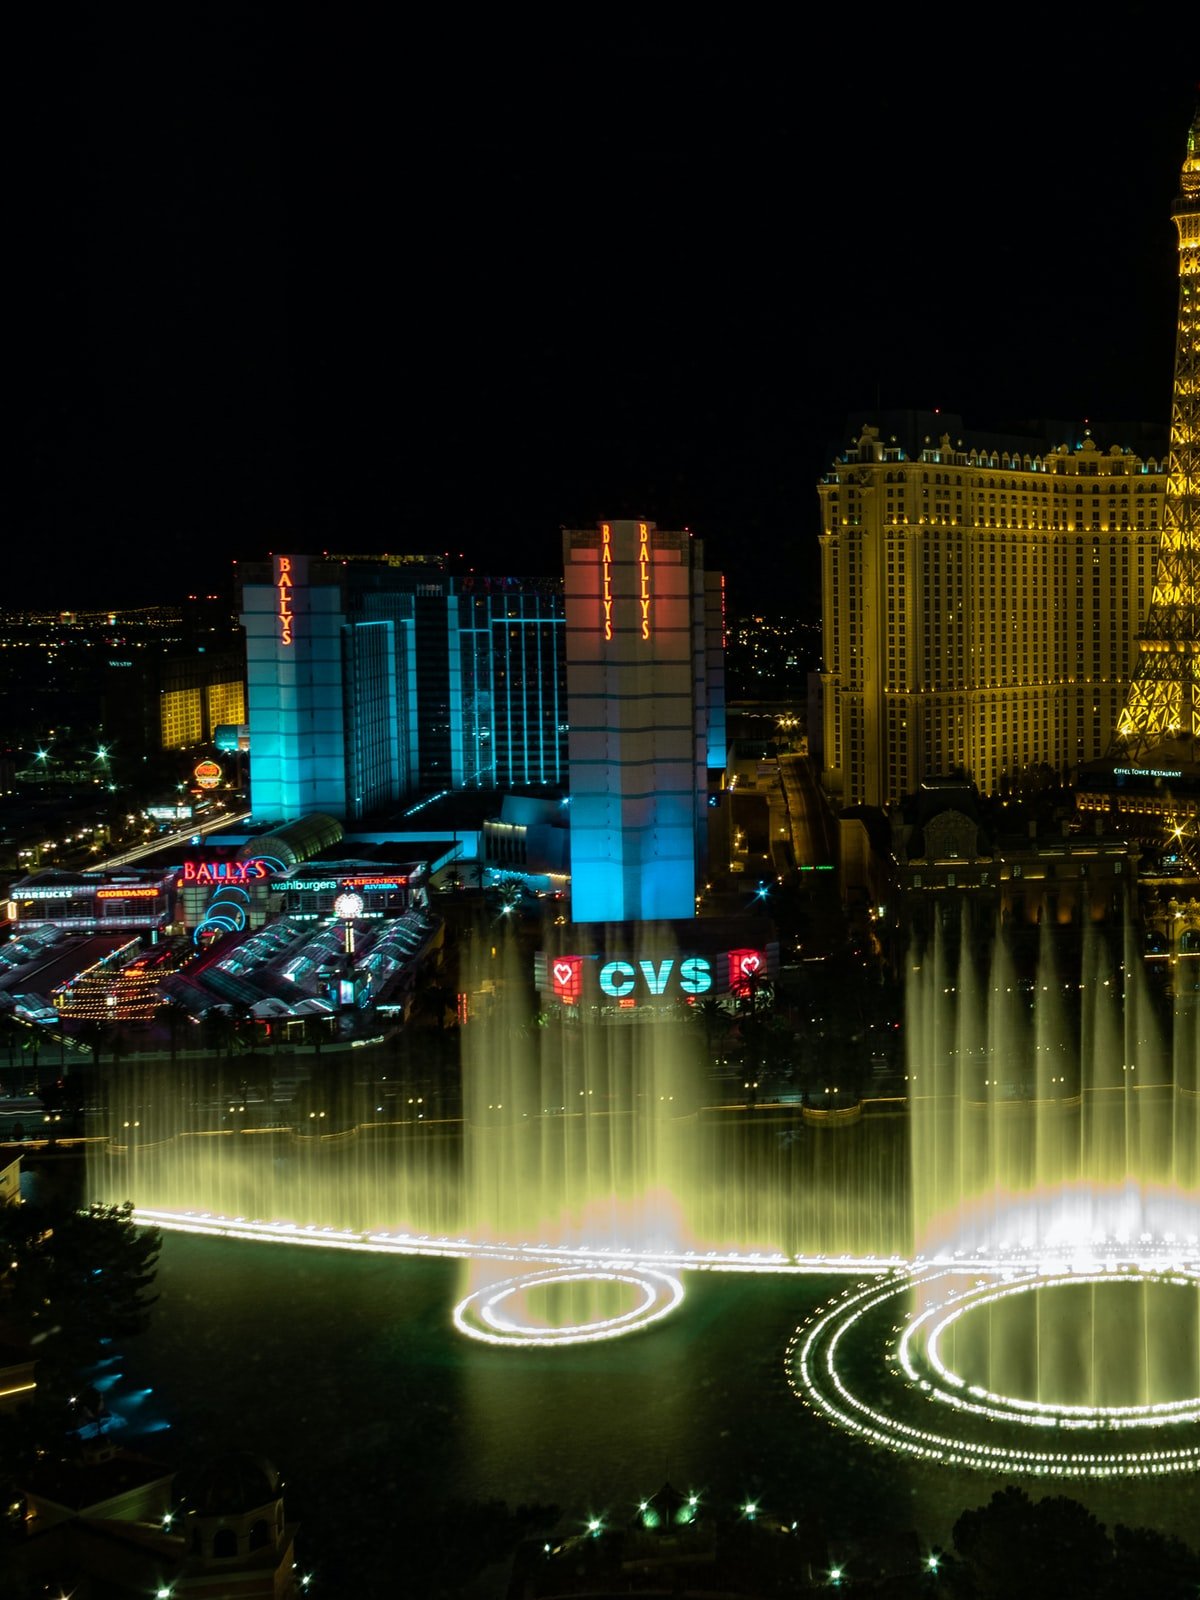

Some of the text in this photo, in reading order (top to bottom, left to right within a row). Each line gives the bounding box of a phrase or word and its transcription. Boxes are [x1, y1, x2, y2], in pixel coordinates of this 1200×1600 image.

[184, 860, 267, 880] BALLY'S
[271, 880, 337, 891] wahlburgers
[354, 877, 406, 886] REDNECK
[11, 890, 72, 899] STARBUCKS
[97, 888, 159, 898] GIORDANO'S
[599, 957, 712, 997] CVS
